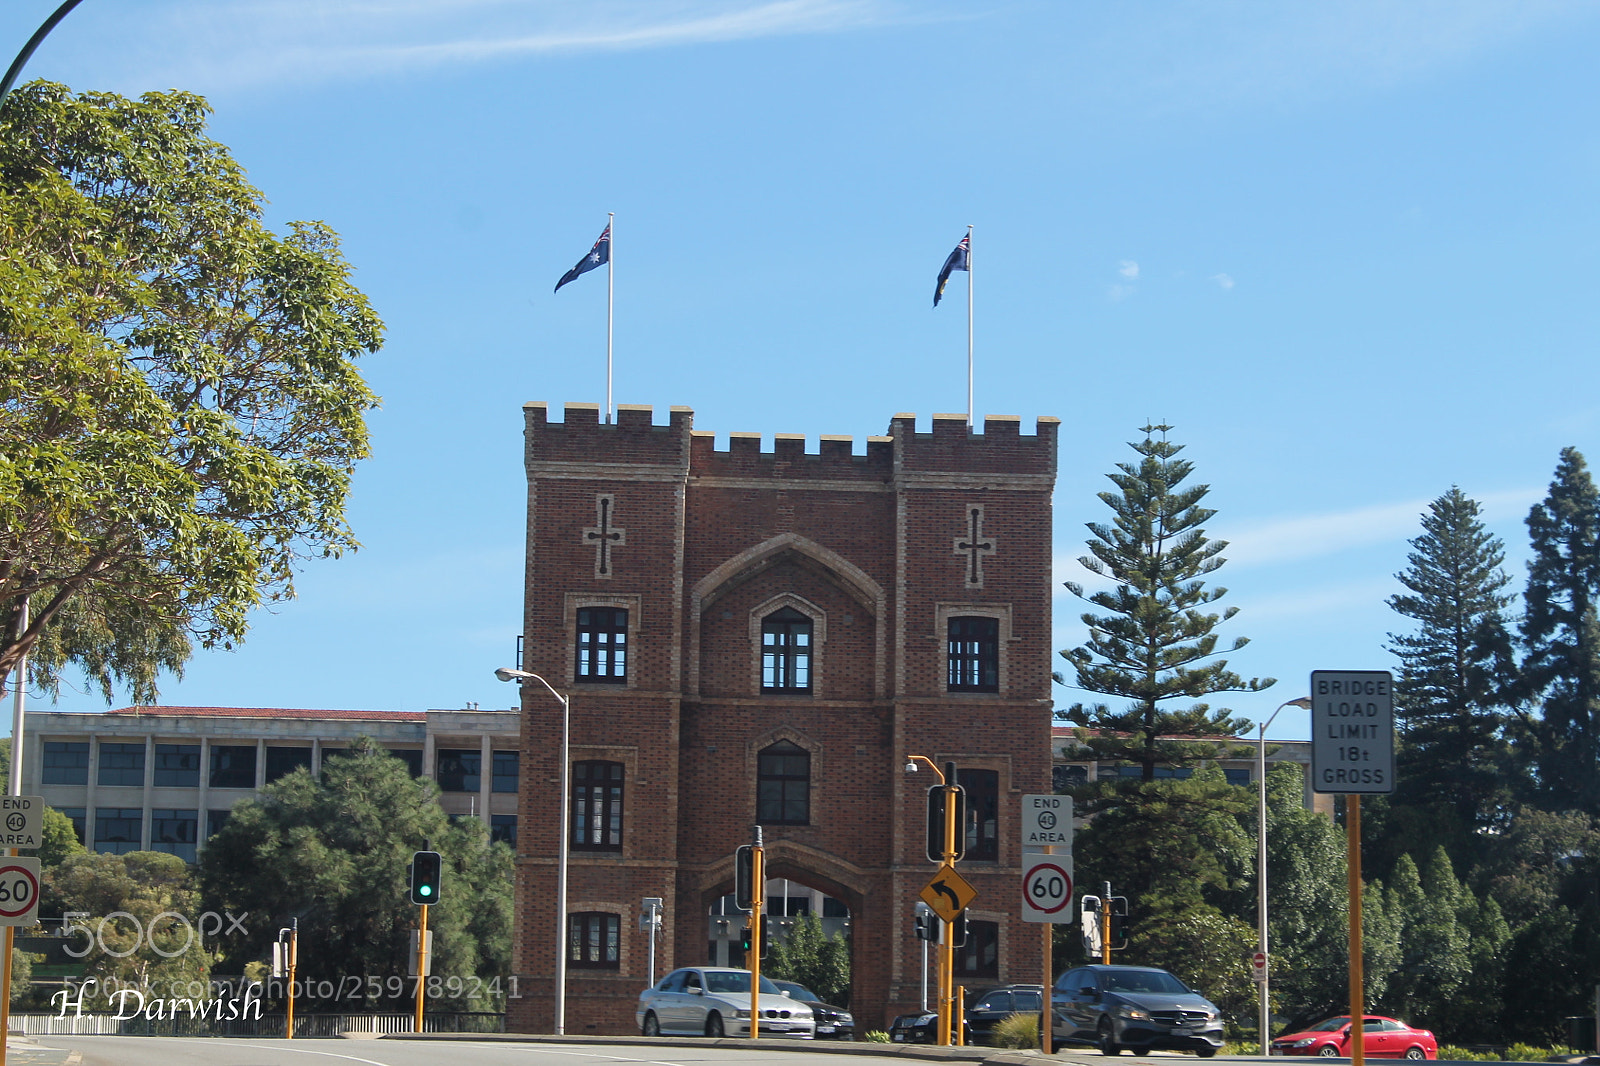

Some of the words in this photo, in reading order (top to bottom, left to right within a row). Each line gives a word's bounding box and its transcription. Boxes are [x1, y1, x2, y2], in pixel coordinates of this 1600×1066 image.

[1318, 680, 1388, 696] BRIDGE
[1328, 702, 1378, 717] LOAD
[1328, 724, 1379, 739] LIMIT
[1323, 768, 1384, 784] GROSS
[3, 799, 31, 810] END
[1033, 799, 1060, 809] END
[8, 817, 24, 827] 40
[1040, 815, 1054, 826] 40
[1029, 832, 1066, 842] AREA
[0, 880, 29, 902] 60
[1032, 876, 1063, 899] 60
